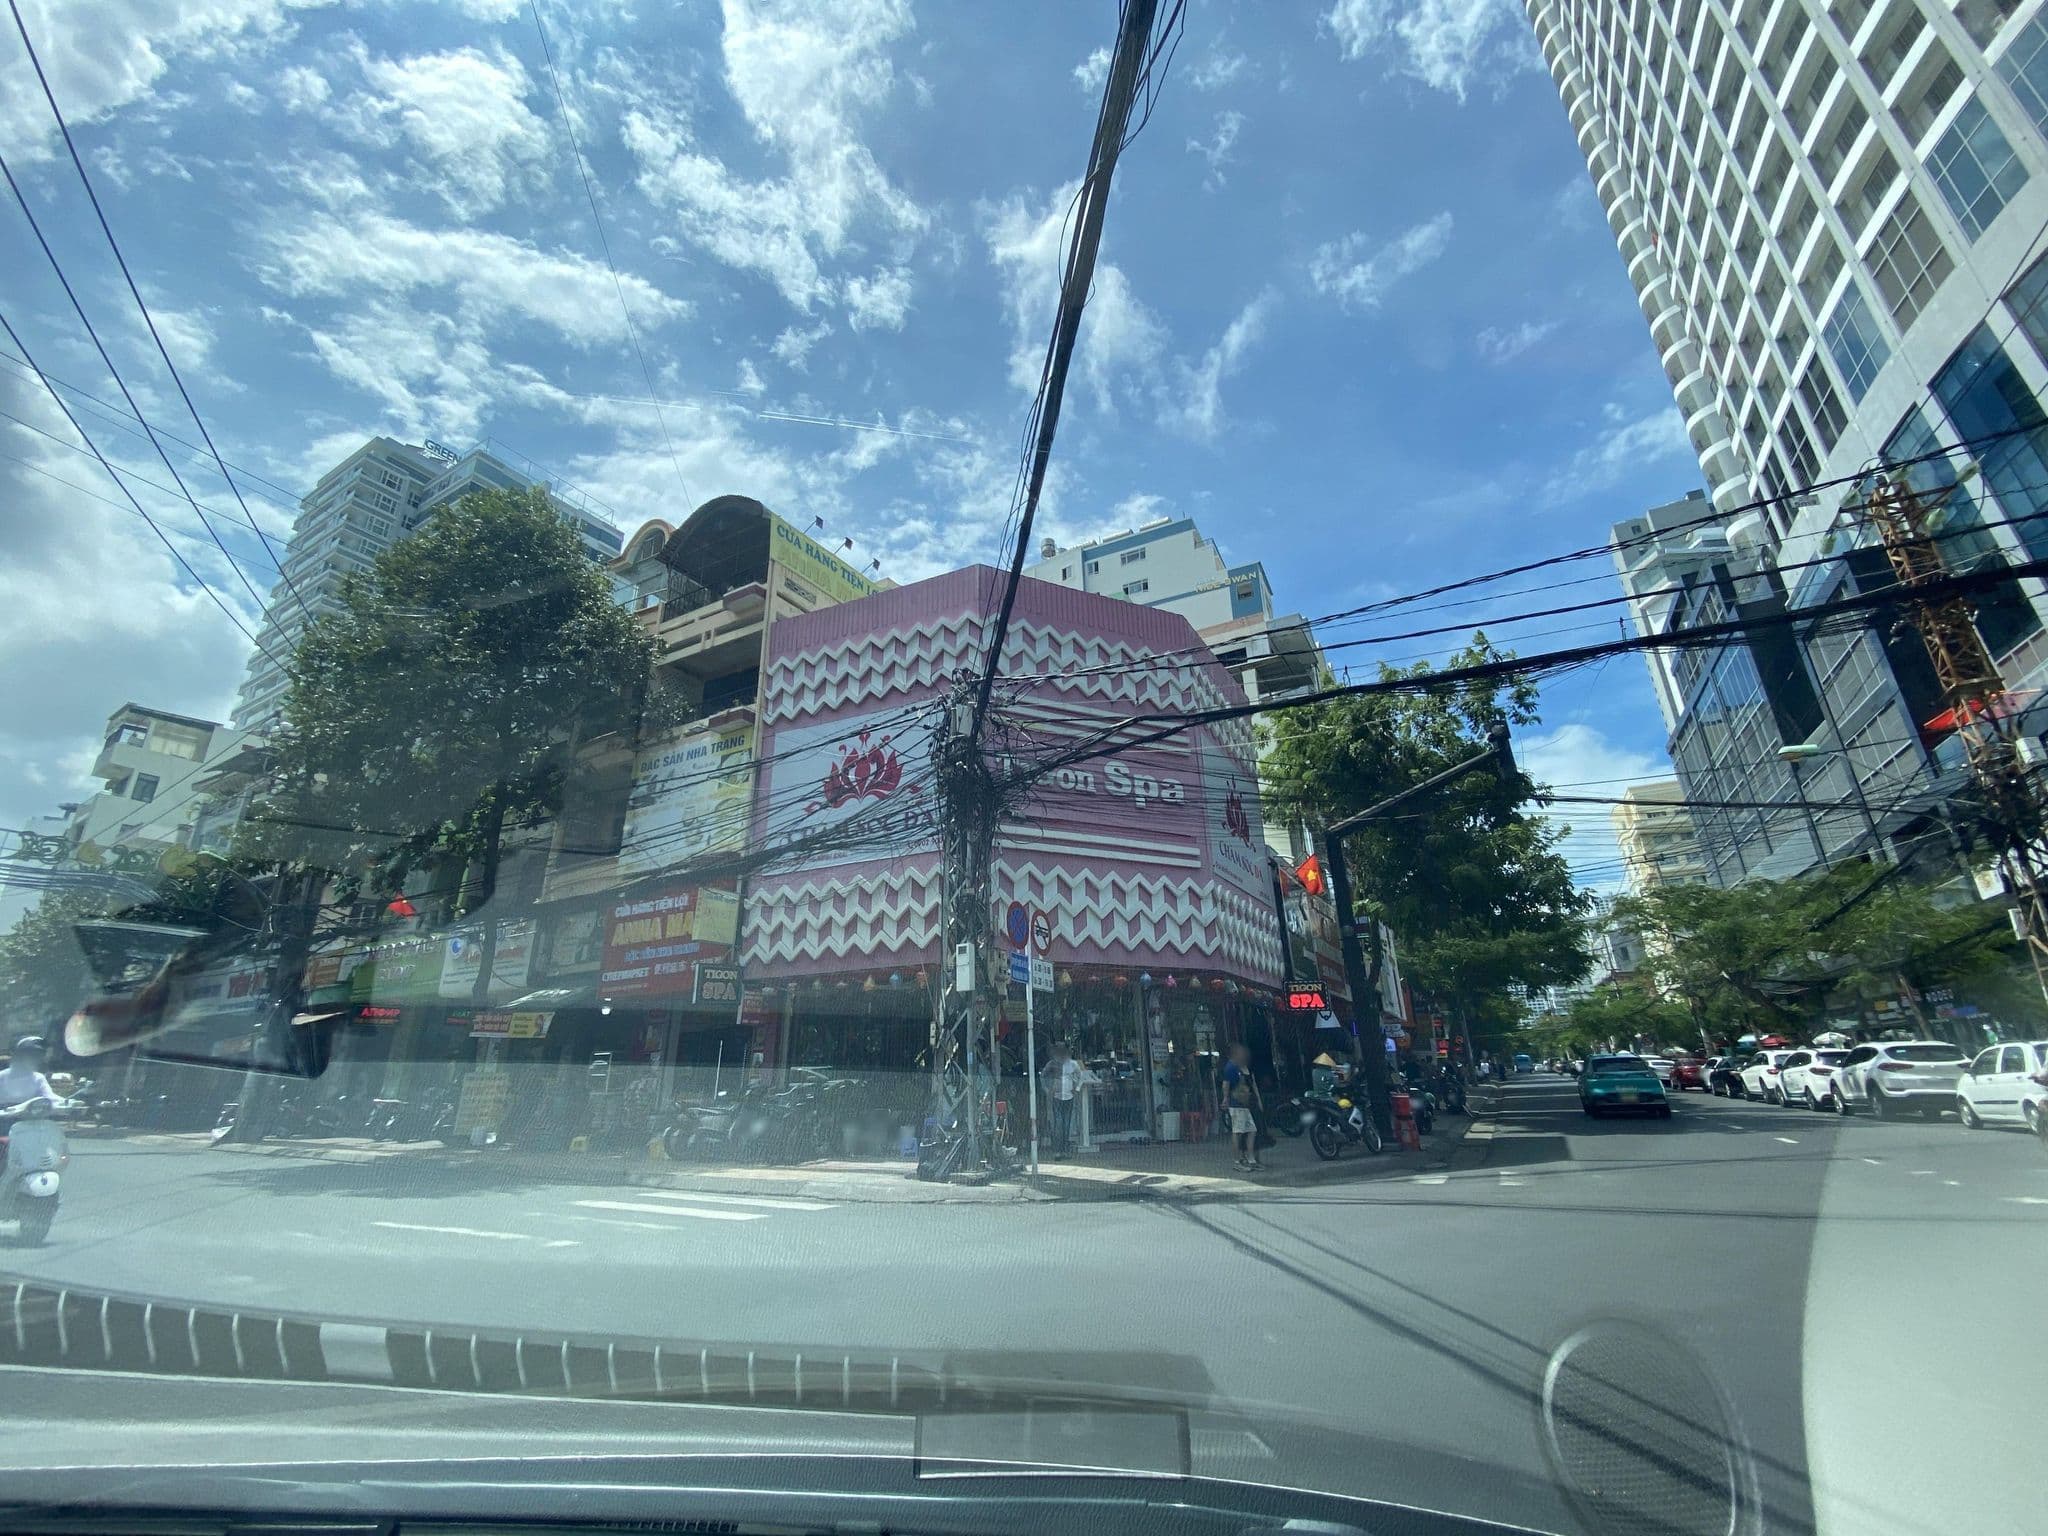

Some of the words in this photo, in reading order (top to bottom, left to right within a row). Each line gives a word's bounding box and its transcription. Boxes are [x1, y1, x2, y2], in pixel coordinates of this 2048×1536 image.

[711, 735, 745, 754] TRANG
[1103, 760, 1186, 810] Spa
[702, 981, 737, 1001] SPA
[1288, 983, 1323, 992] TIGON
[1289, 993, 1326, 1009] SPA
